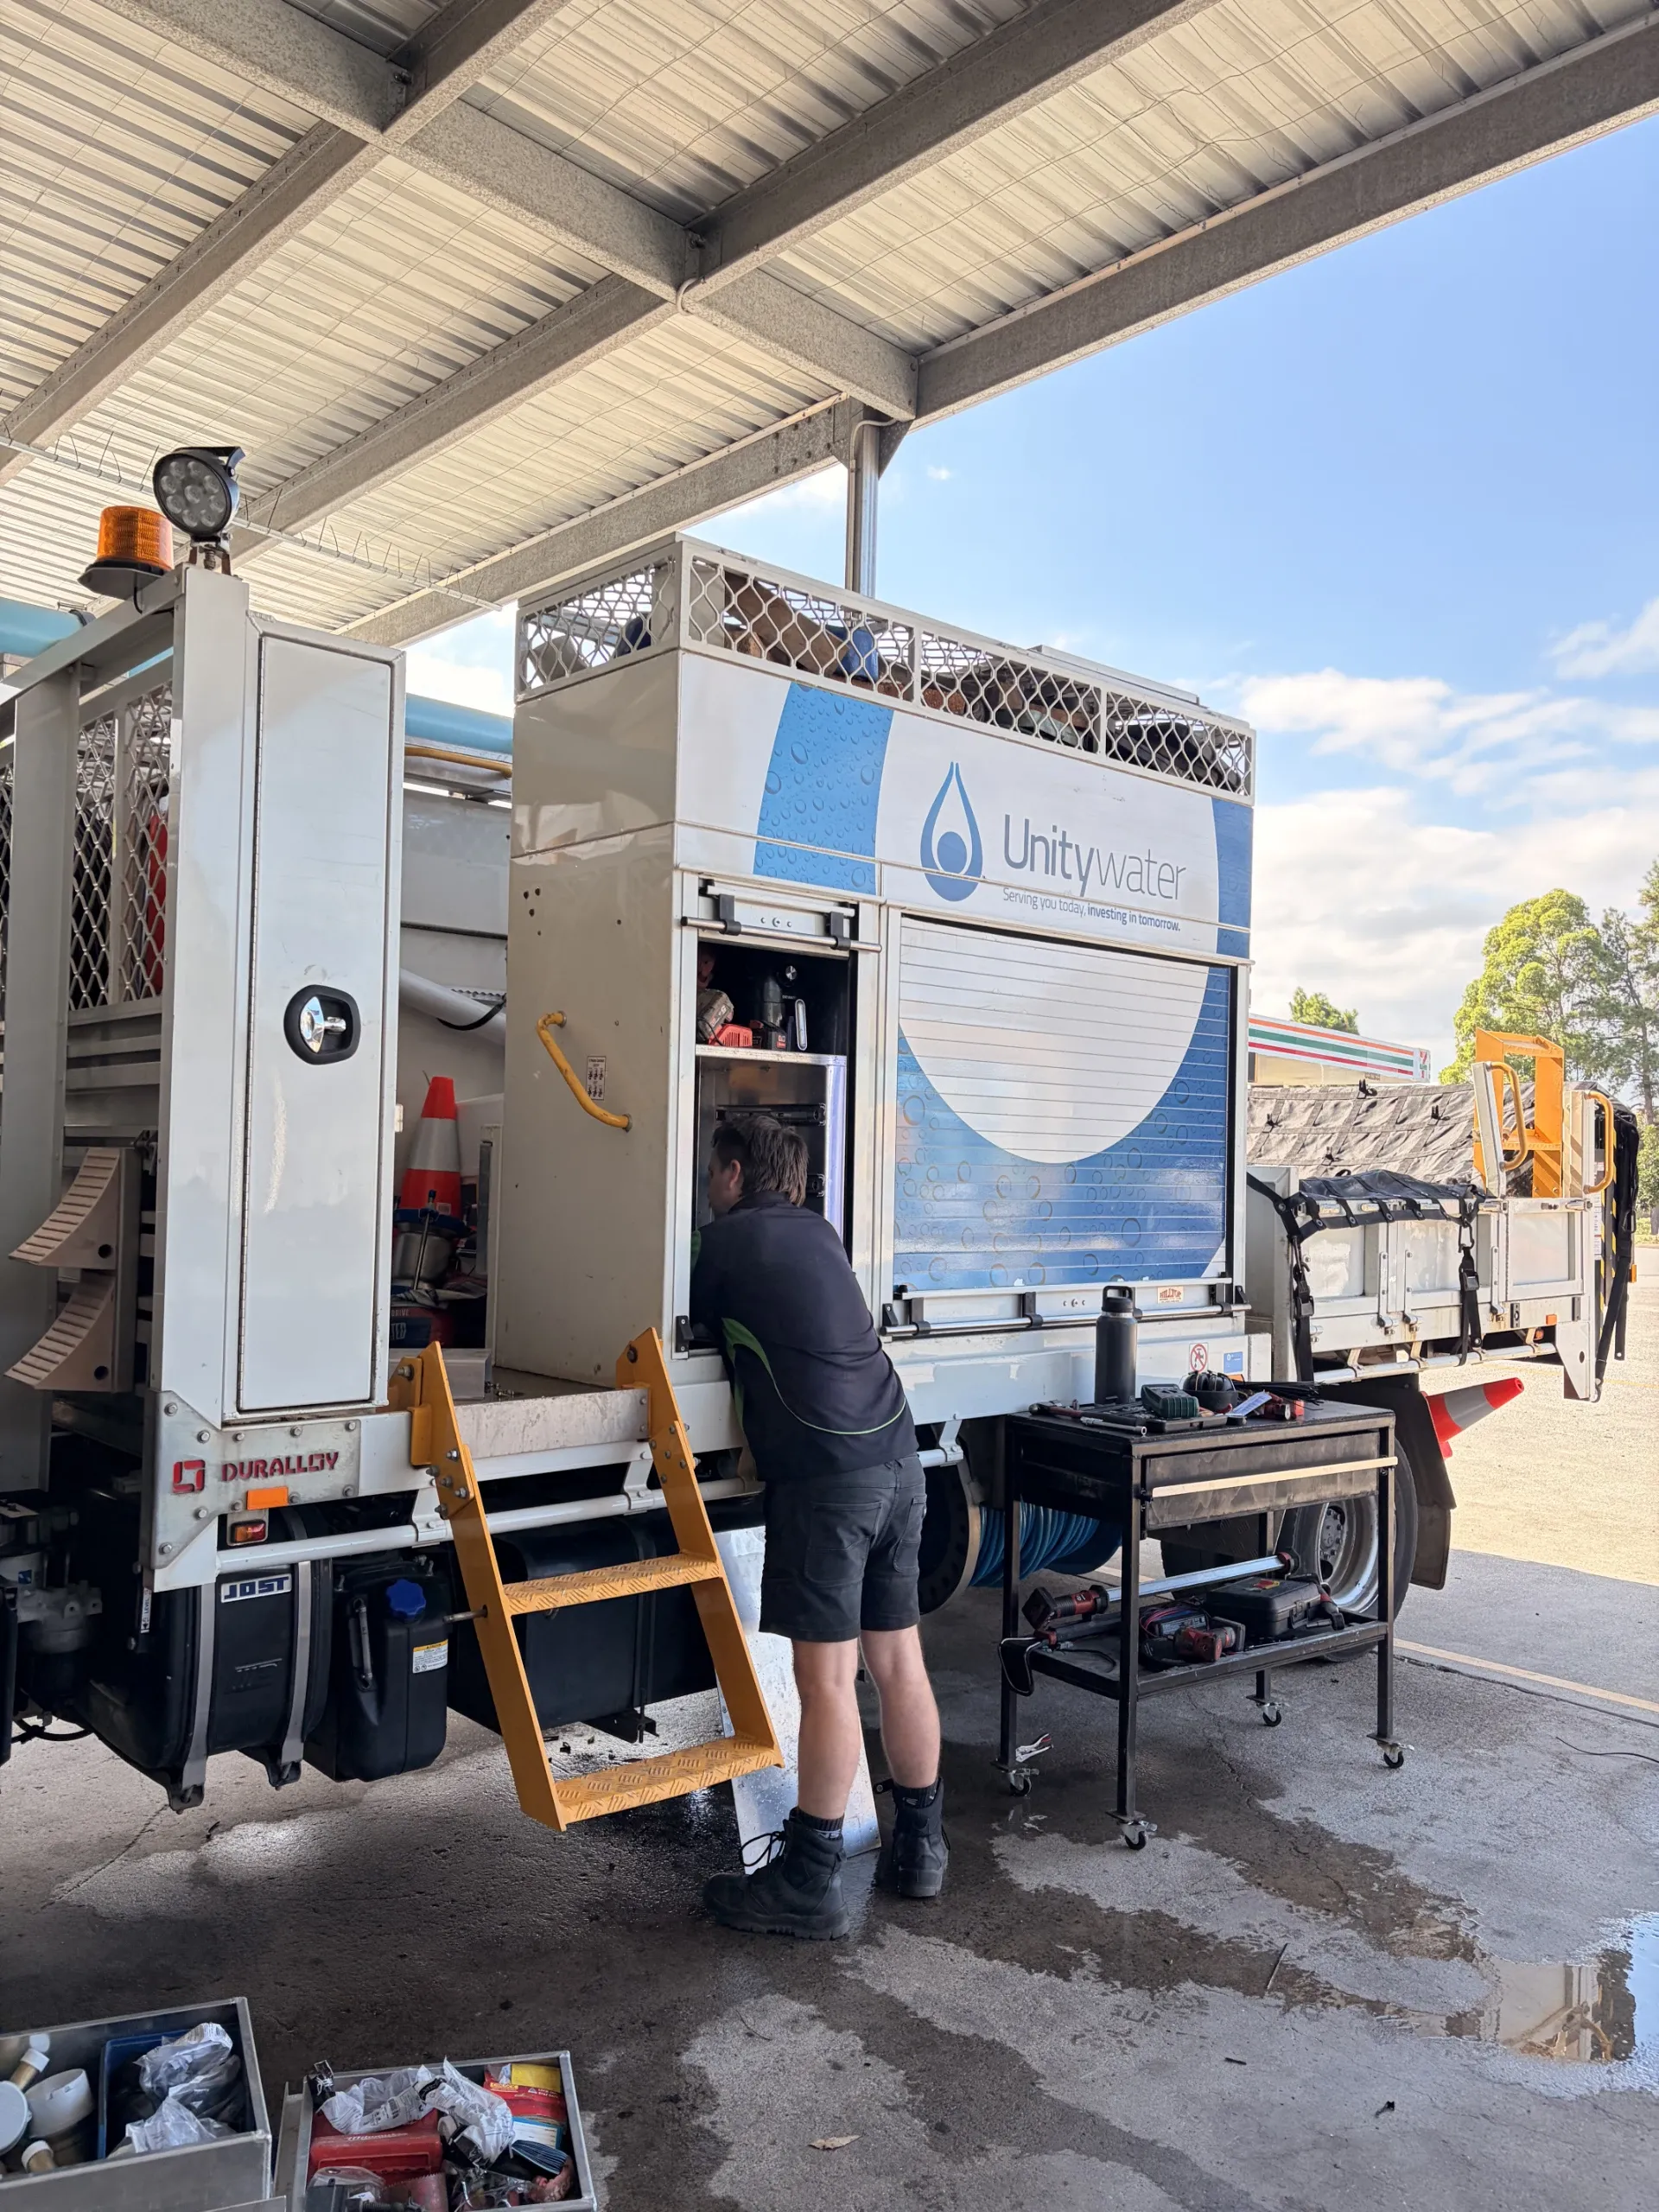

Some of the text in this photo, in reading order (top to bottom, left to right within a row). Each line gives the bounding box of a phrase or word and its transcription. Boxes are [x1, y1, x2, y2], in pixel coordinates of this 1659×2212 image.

[1004, 814, 1186, 899] Unitywater
[1003, 887, 1181, 931] Serving you today, investing in tomorrow.
[221, 1452, 339, 1482] DURALLOY
[224, 1576, 289, 1600] JOST
